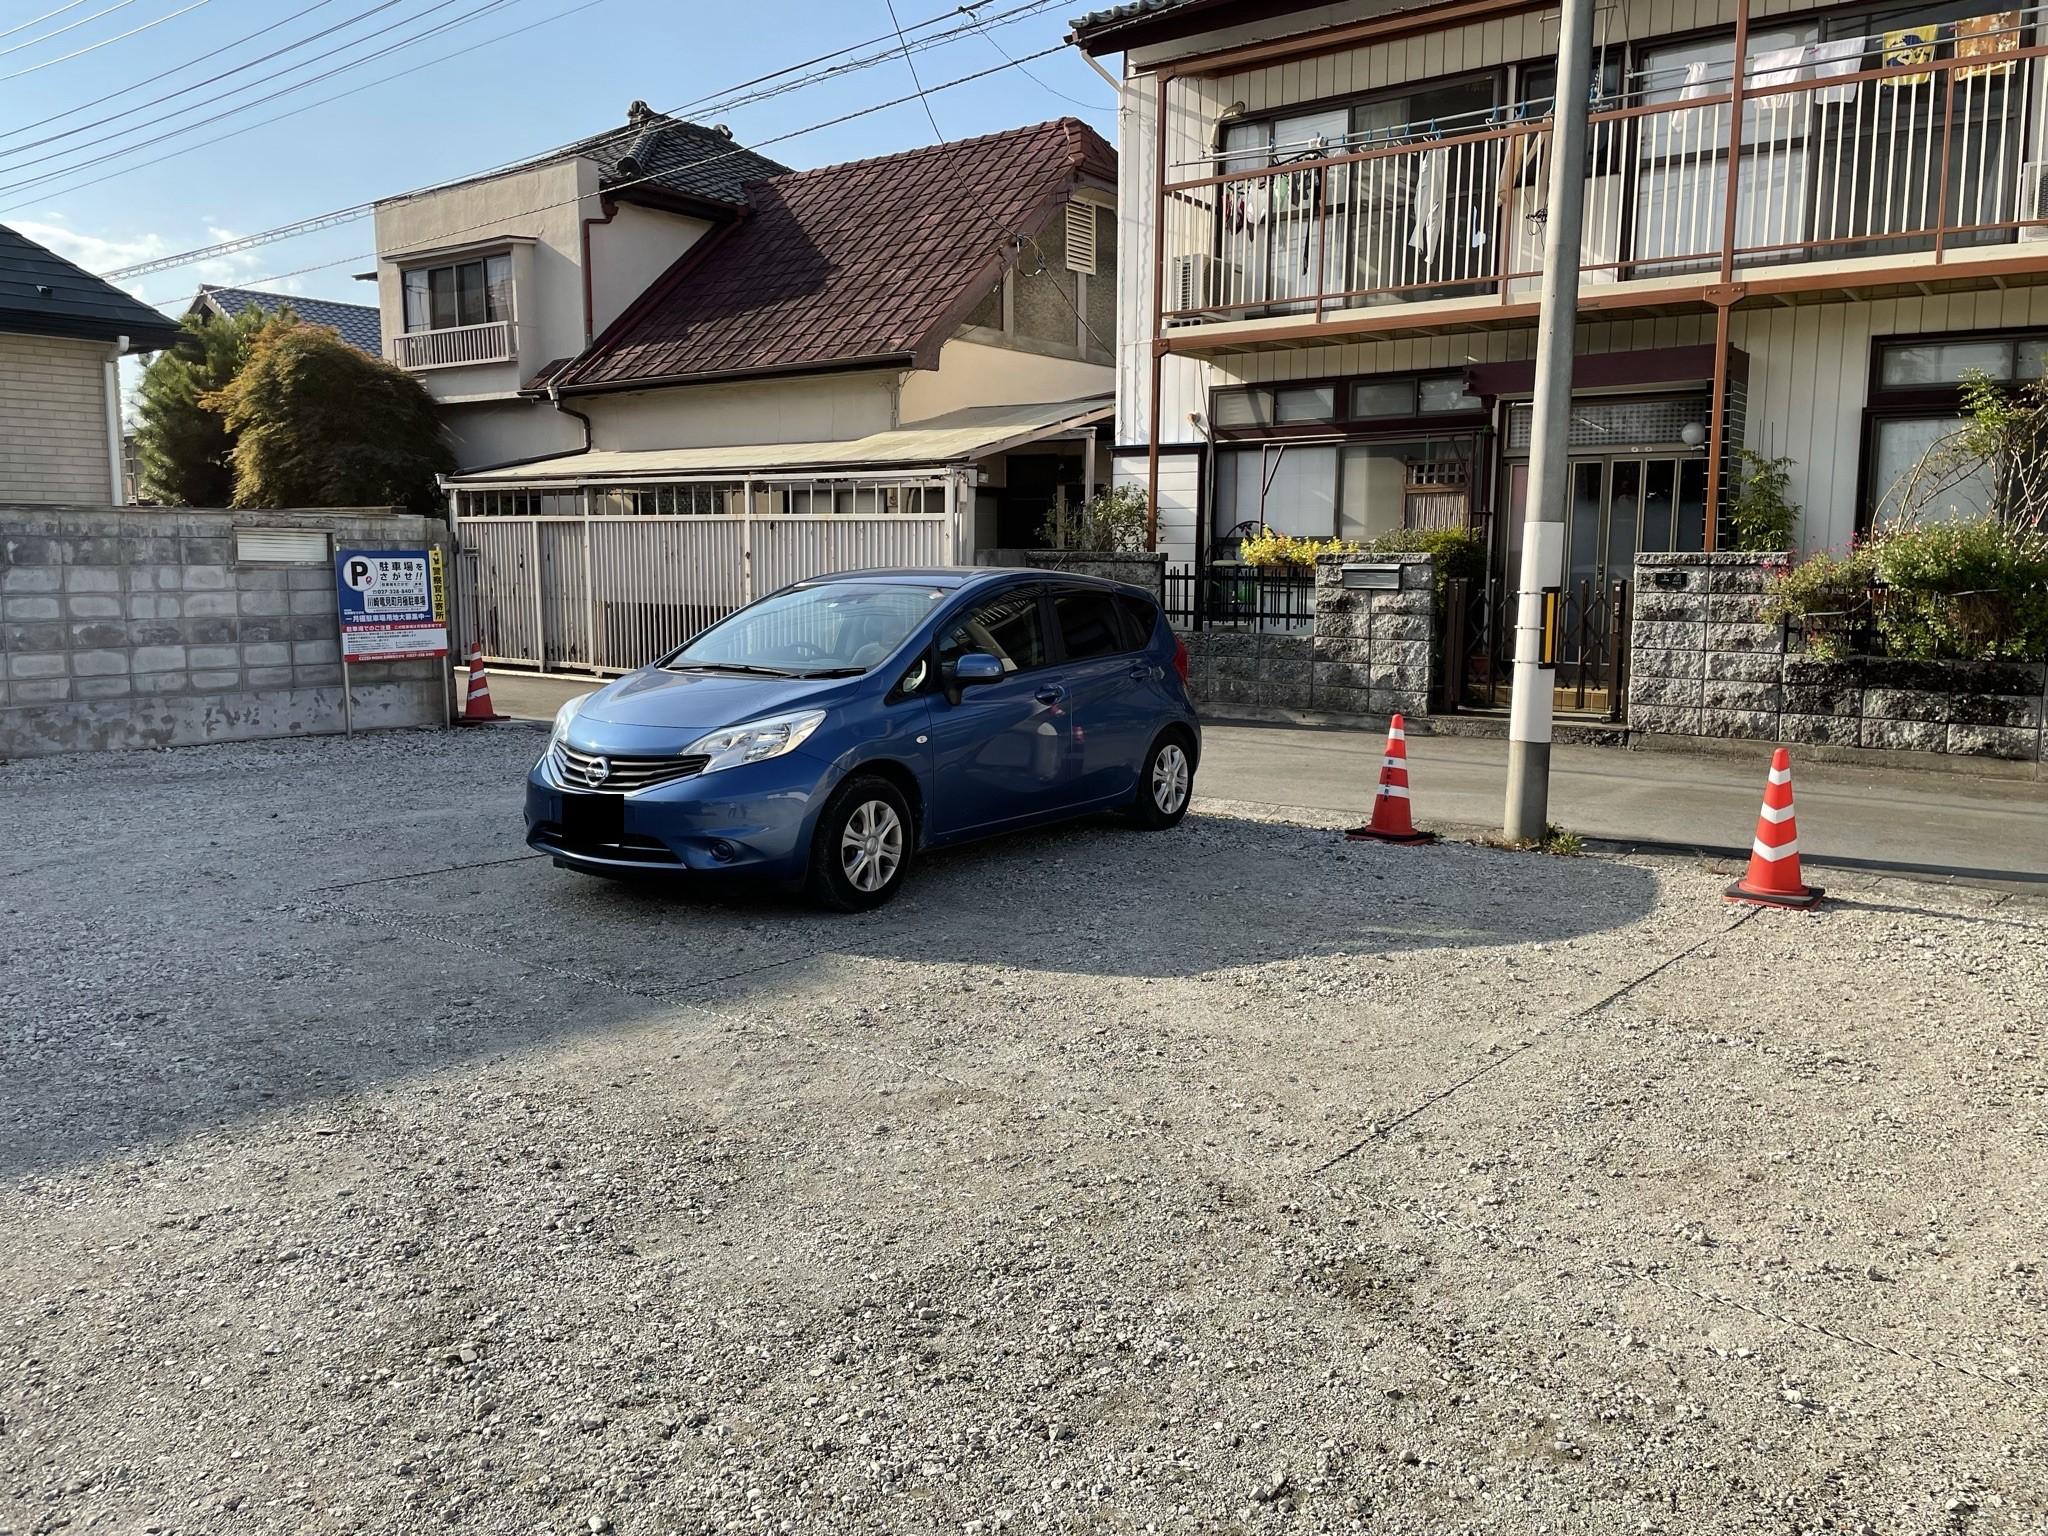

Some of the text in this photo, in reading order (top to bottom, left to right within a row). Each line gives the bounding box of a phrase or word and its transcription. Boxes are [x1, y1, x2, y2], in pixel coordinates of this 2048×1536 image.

[351, 561, 368, 586] P
[379, 561, 423, 572] 駐車場を
[432, 567, 444, 620] 警察官立寄所
